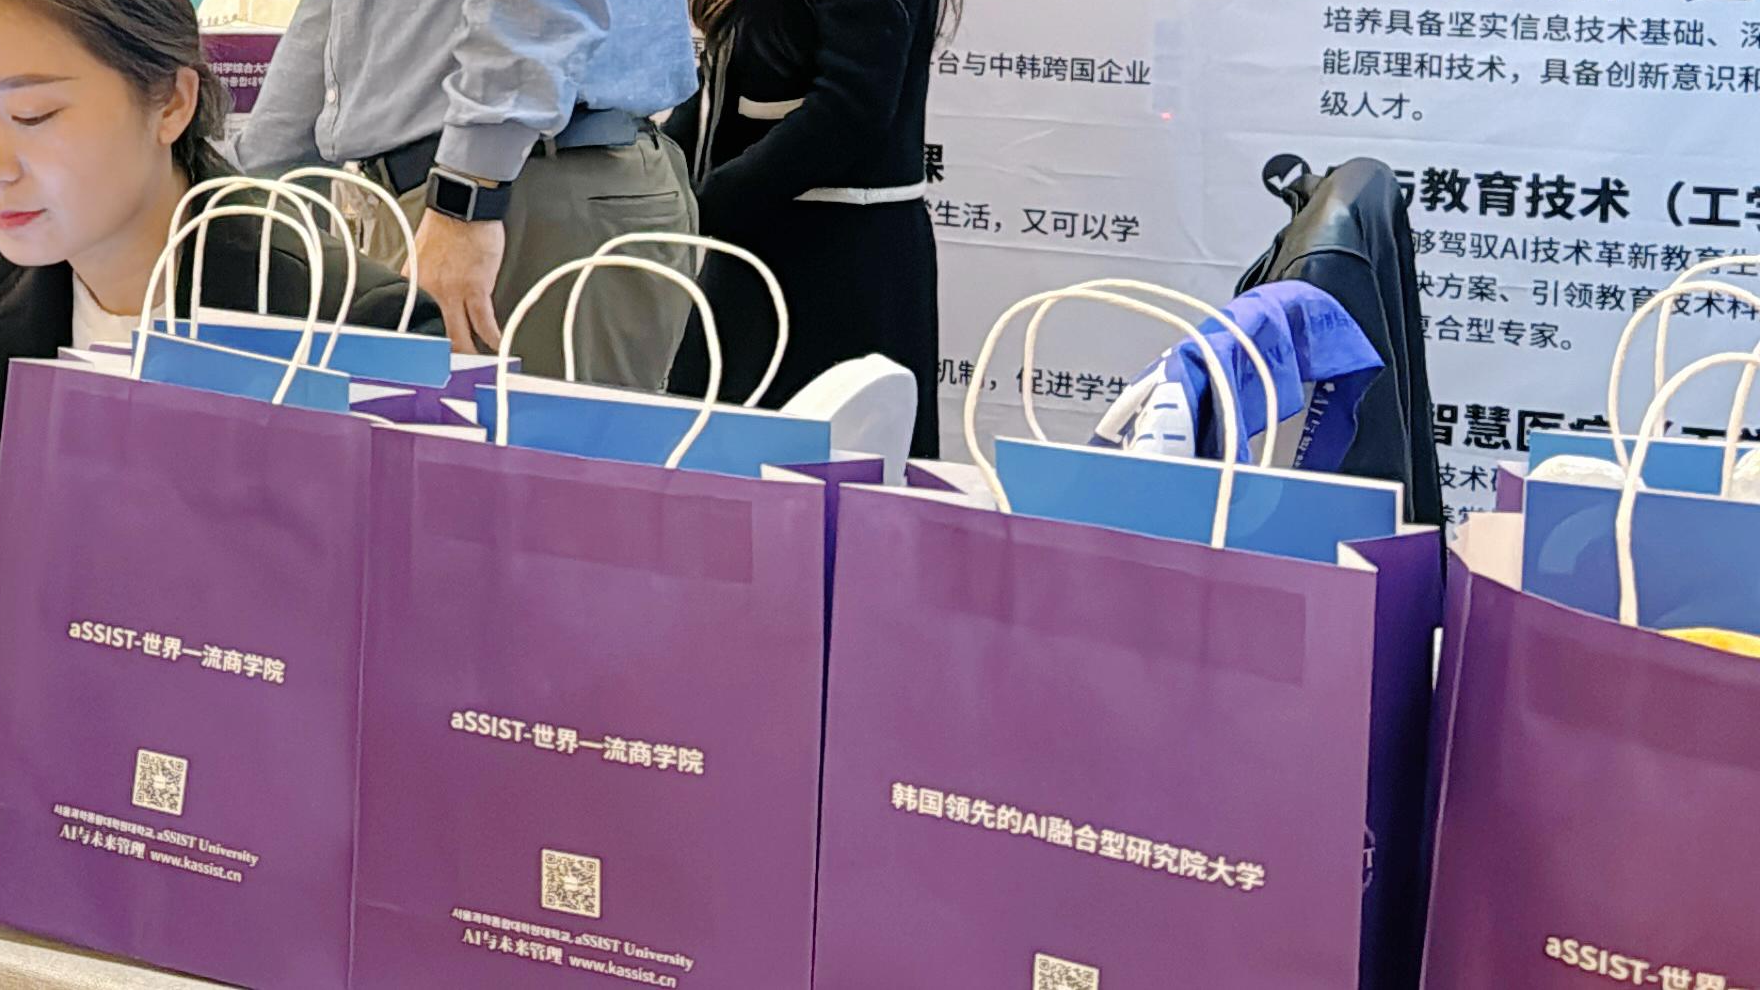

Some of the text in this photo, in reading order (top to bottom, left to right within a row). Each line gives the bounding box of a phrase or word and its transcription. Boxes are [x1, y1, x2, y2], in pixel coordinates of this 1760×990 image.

[1320, 92, 1426, 122] 级人才。
[68, 619, 286, 684] aSSIST-世界一流商学院
[450, 709, 705, 775] aSSIST-世界一流商学院
[156, 827, 197, 850] aSSIST
[198, 838, 260, 867] University
[891, 781, 1266, 892] 韩国领先的AI融合型研究院大学
[149, 847, 242, 883] www.kassist.cn
[568, 953, 677, 989] www.kassist.cn
[575, 932, 621, 956] aSSIST
[623, 941, 695, 973] University
[1544, 935, 1760, 990] aSSIST-世界
